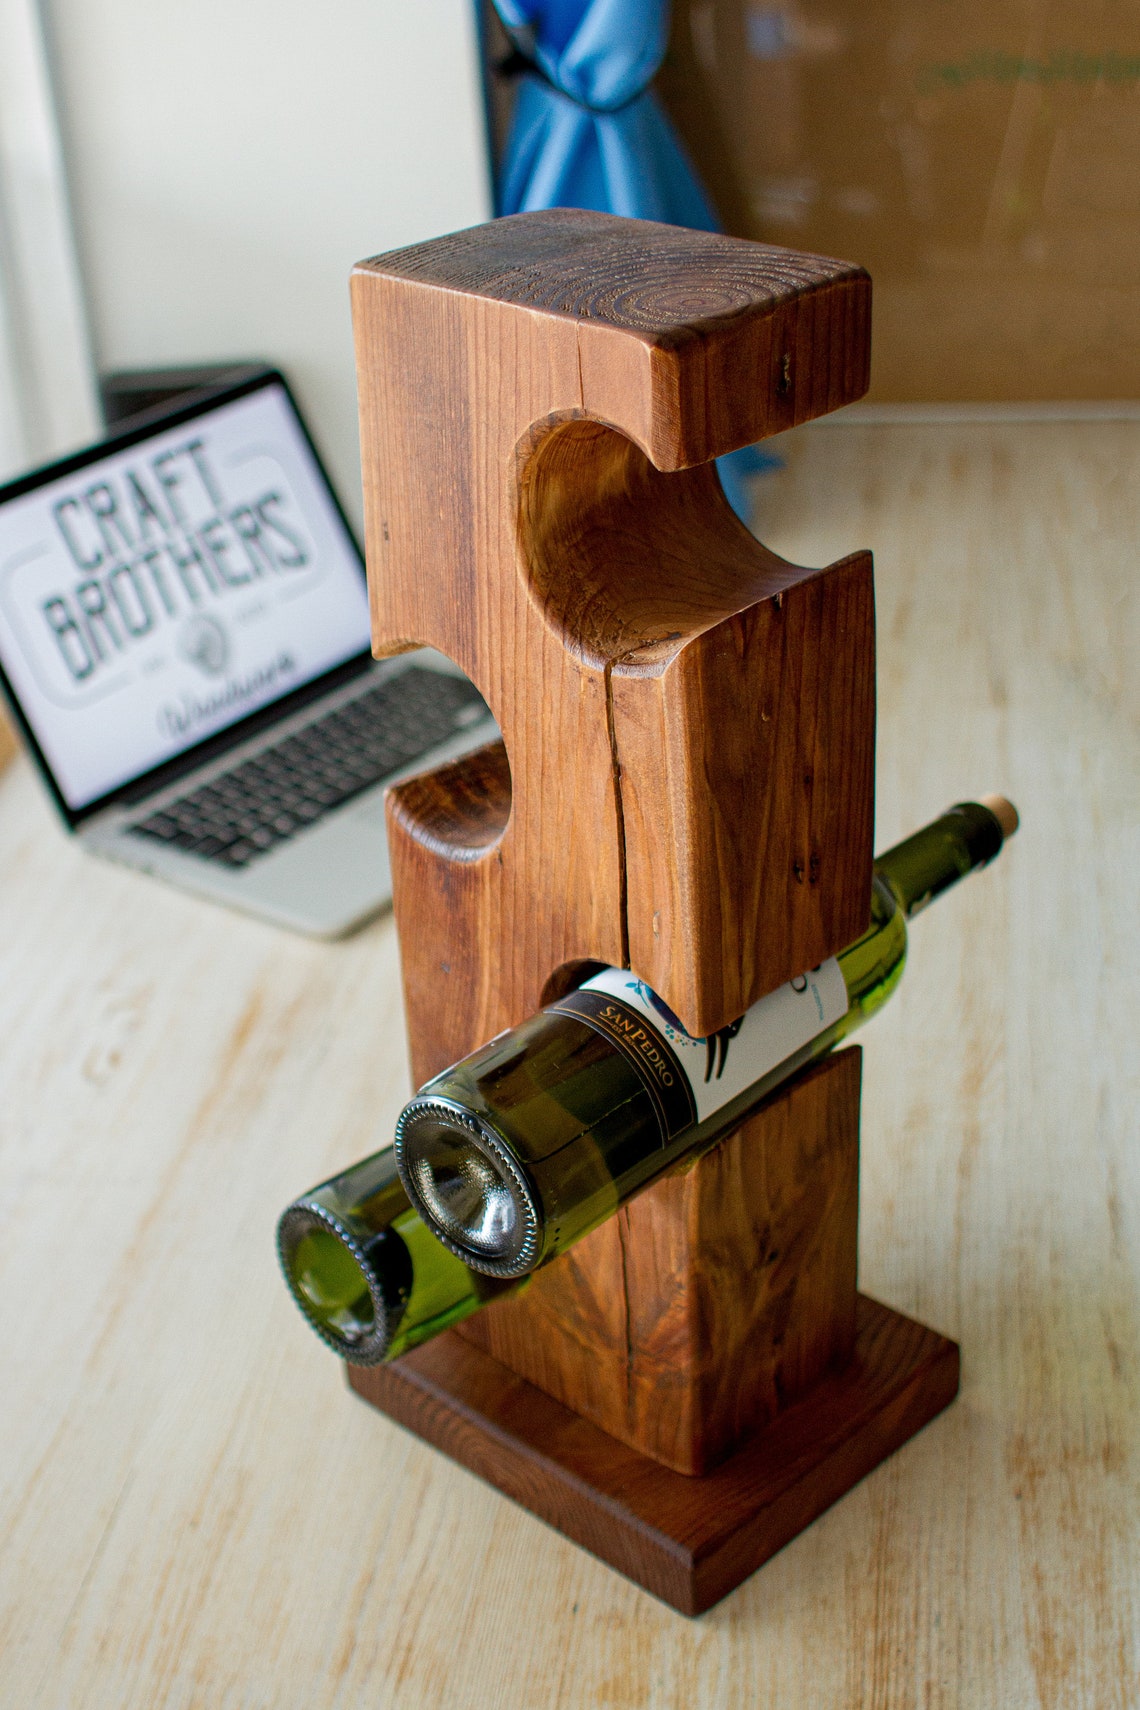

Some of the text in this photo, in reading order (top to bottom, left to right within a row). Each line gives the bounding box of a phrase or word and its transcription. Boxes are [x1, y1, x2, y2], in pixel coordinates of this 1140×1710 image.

[53, 440, 224, 571] CRAFT
[43, 492, 309, 683] BROTHERS
[600, 1006, 673, 1086] SAN PEDRO
